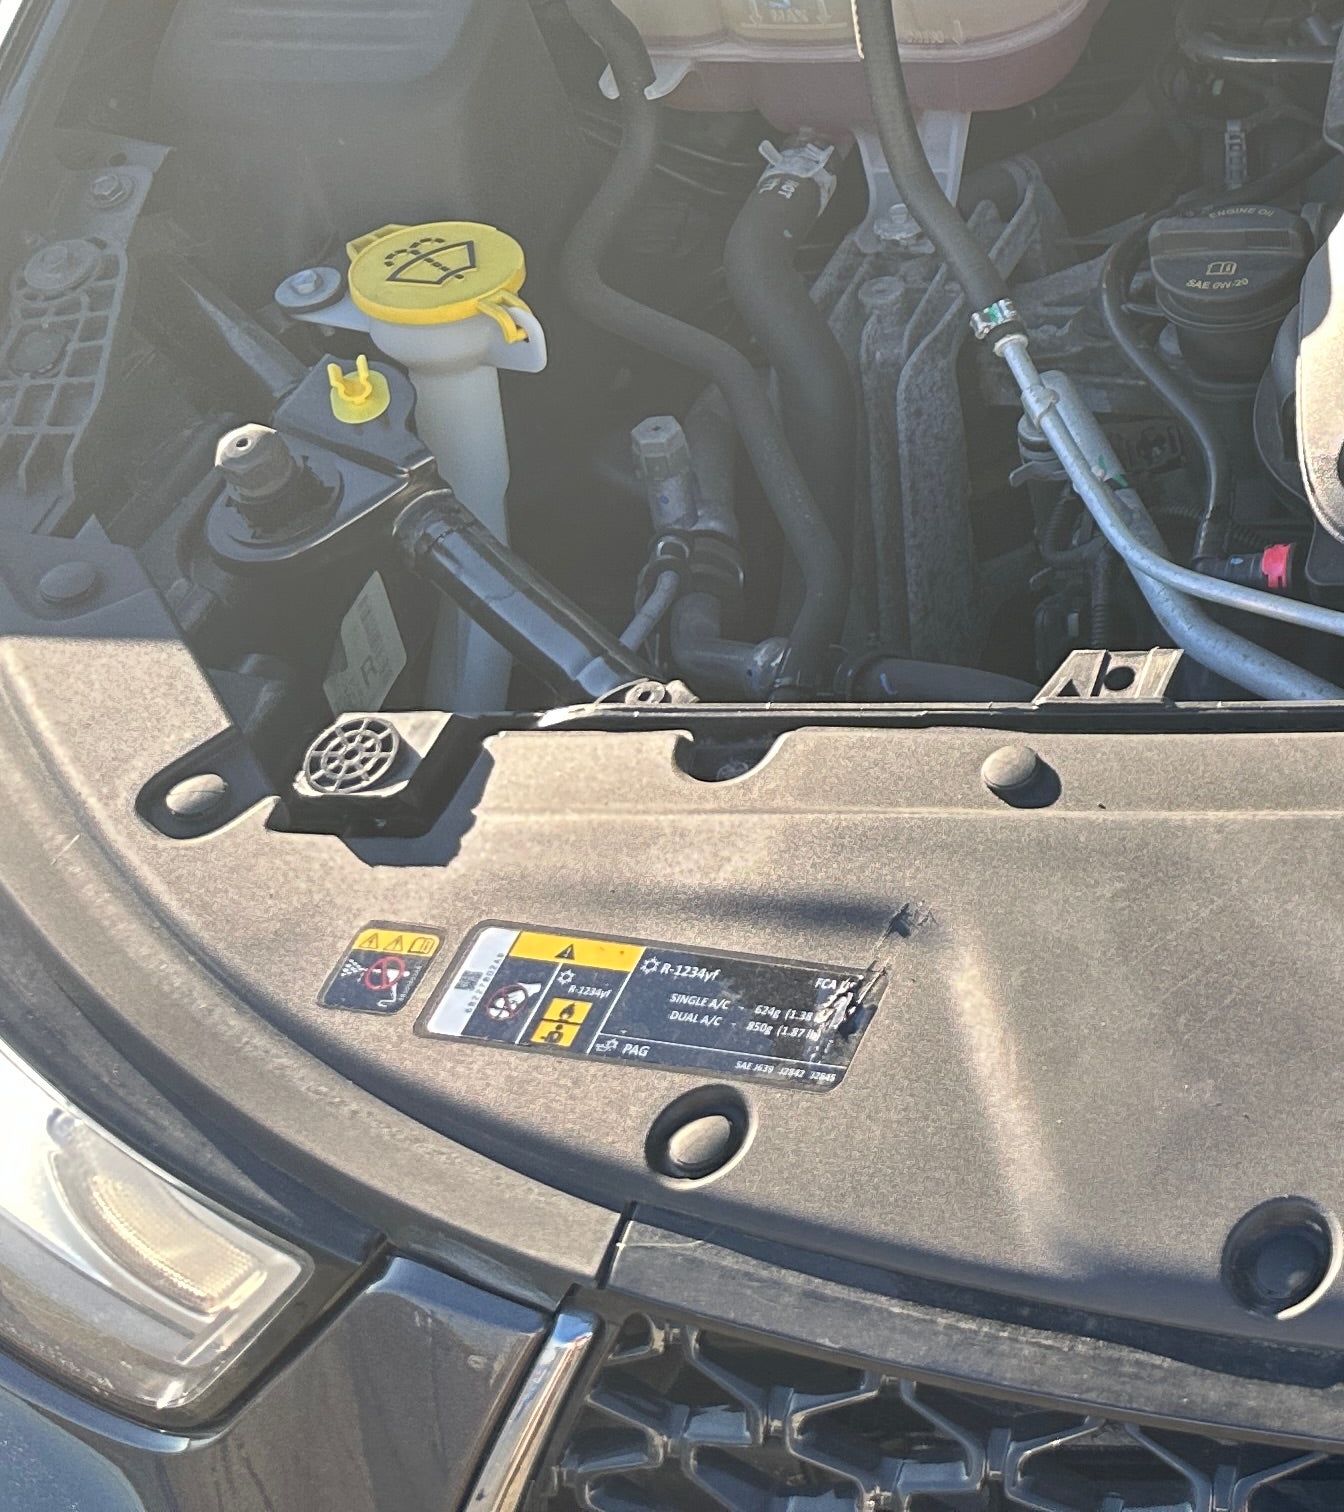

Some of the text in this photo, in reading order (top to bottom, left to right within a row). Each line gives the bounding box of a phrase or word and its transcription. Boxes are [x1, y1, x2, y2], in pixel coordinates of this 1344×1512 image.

[1209, 207, 1256, 218] ENGINE
[1186, 278, 1210, 289] SAE
[660, 962, 721, 983] R-1234yf
[815, 978, 837, 990] FCA
[568, 984, 612, 998] R-1234yf
[670, 993, 708, 1007] SINGLE
[708, 998, 731, 1010] A/C
[754, 1004, 781, 1020] 624g
[669, 1010, 700, 1023] DUAL
[700, 1014, 722, 1026] A/C
[746, 1021, 774, 1038] 850g
[776, 1024, 805, 1038] (1.87
[622, 1044, 650, 1056] PAG
[735, 1060, 753, 1071] SAE
